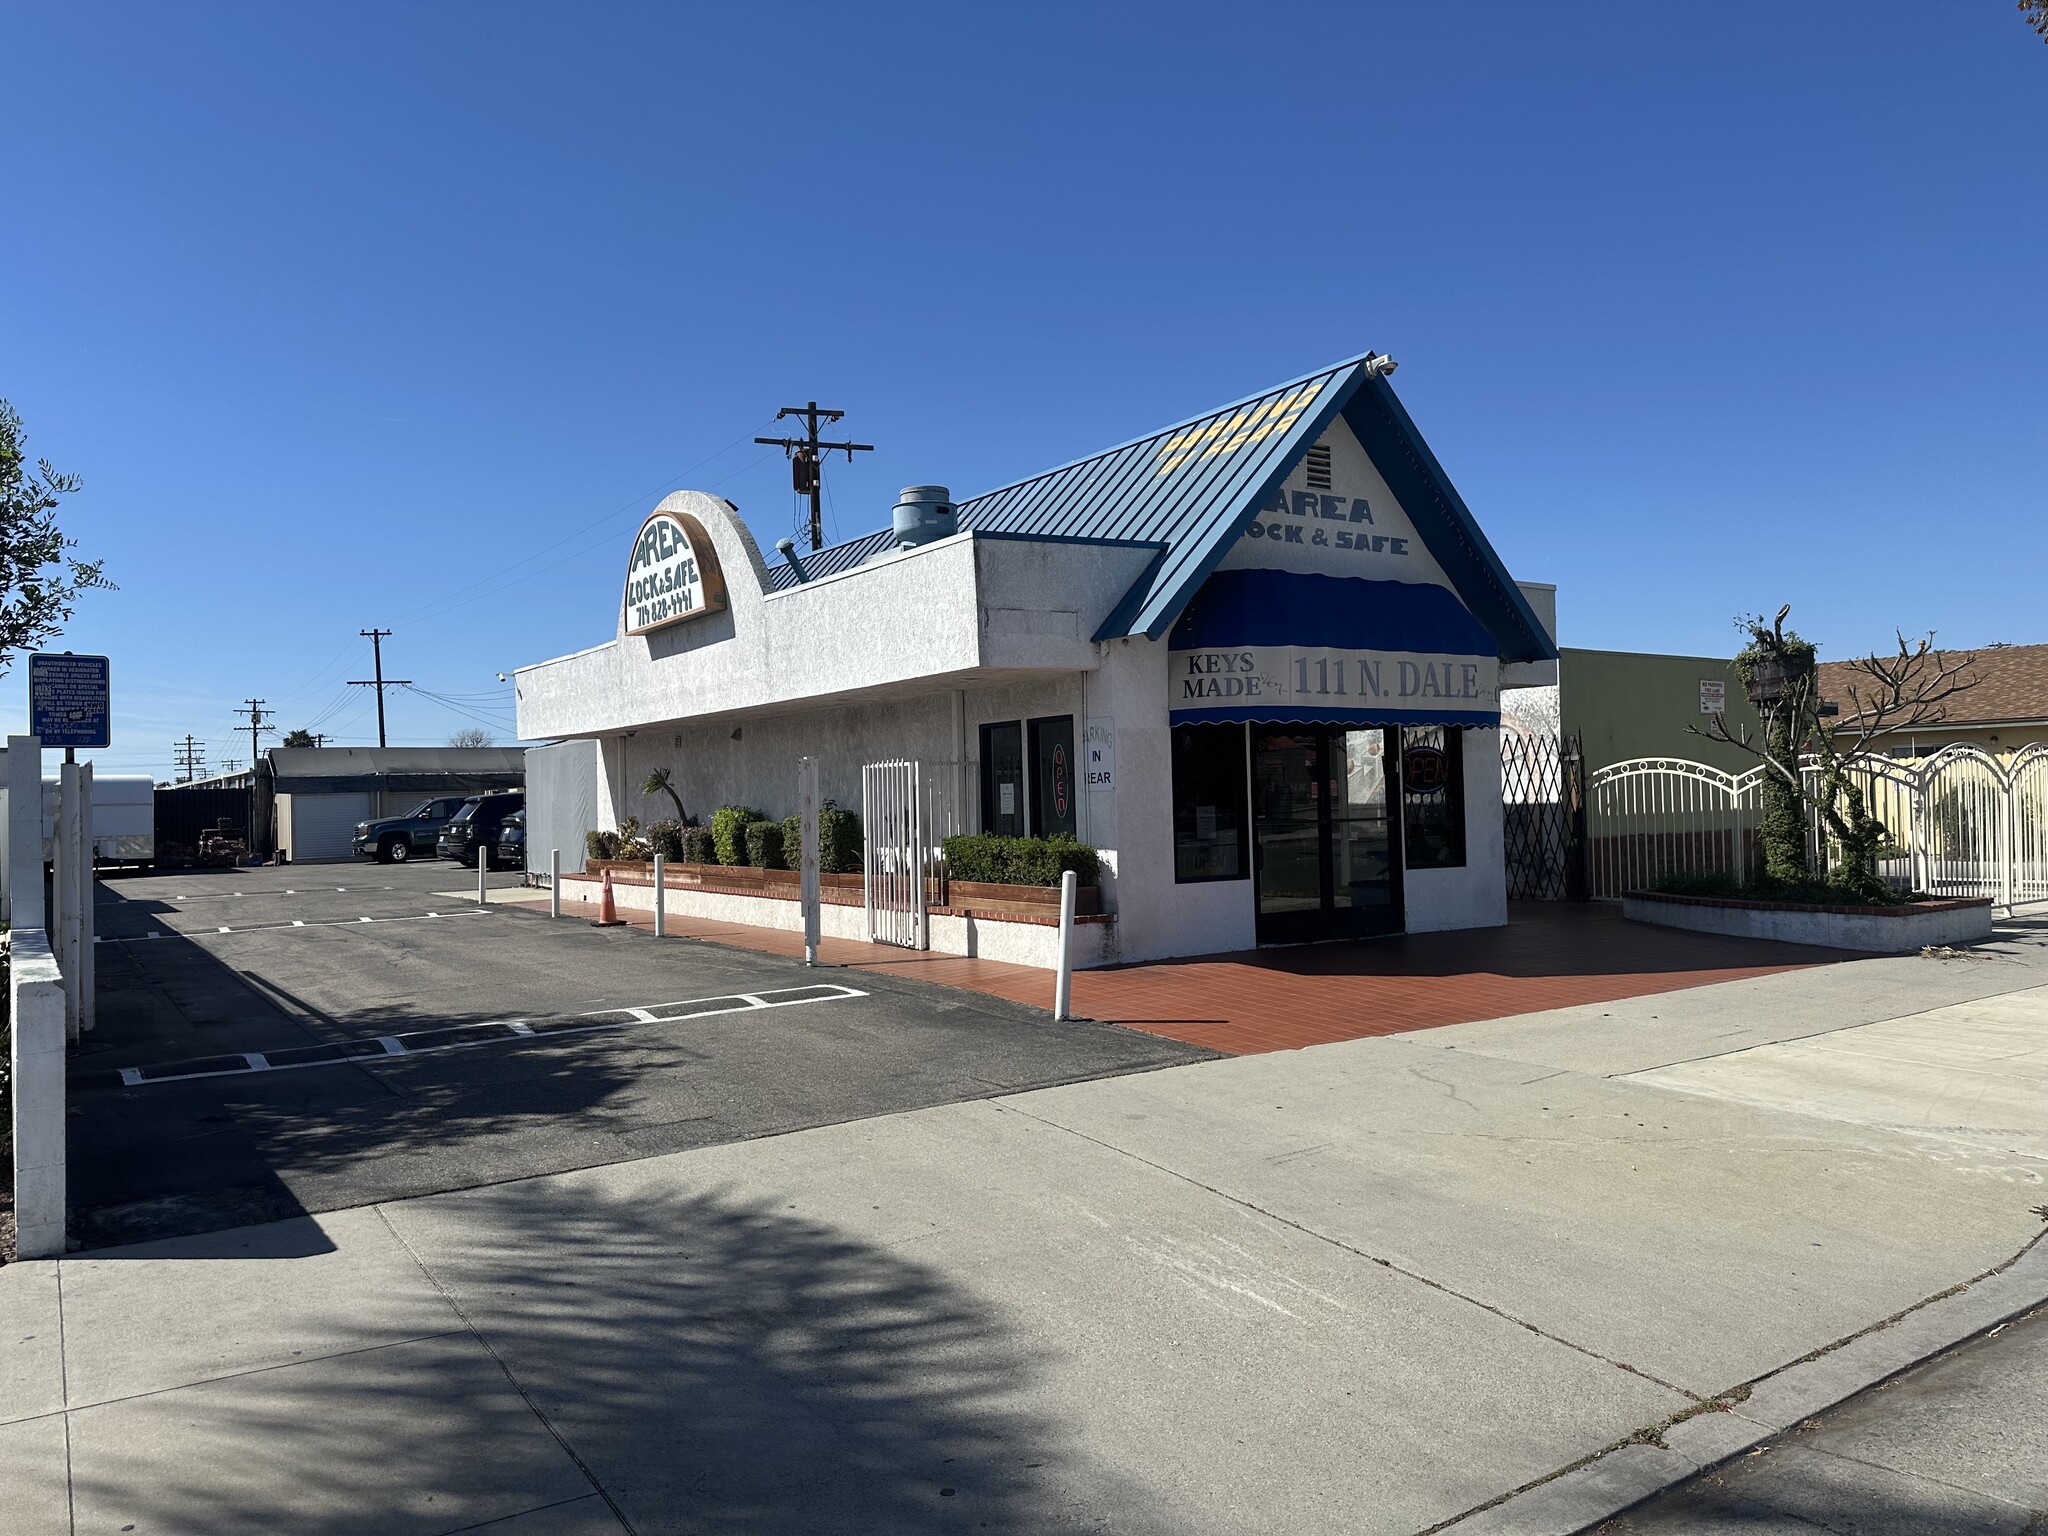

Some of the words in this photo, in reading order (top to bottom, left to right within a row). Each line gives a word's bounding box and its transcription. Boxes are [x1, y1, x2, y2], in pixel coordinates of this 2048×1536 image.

[1156, 384, 1323, 460] PARKING
[1199, 413, 1300, 462] REAR
[1263, 489, 1374, 525] AREA
[632, 521, 689, 573] AREA
[1241, 521, 1304, 544] OCK
[1311, 528, 1329, 547] &
[1335, 531, 1409, 556] SAFE
[636, 604, 650, 627] 714
[1188, 652, 1254, 675] KEYS
[1295, 657, 1347, 695] 111
[1358, 659, 1389, 697] N.
[1397, 661, 1478, 699] DALE
[1183, 677, 1262, 699] MADE
[1092, 750, 1101, 762] IN
